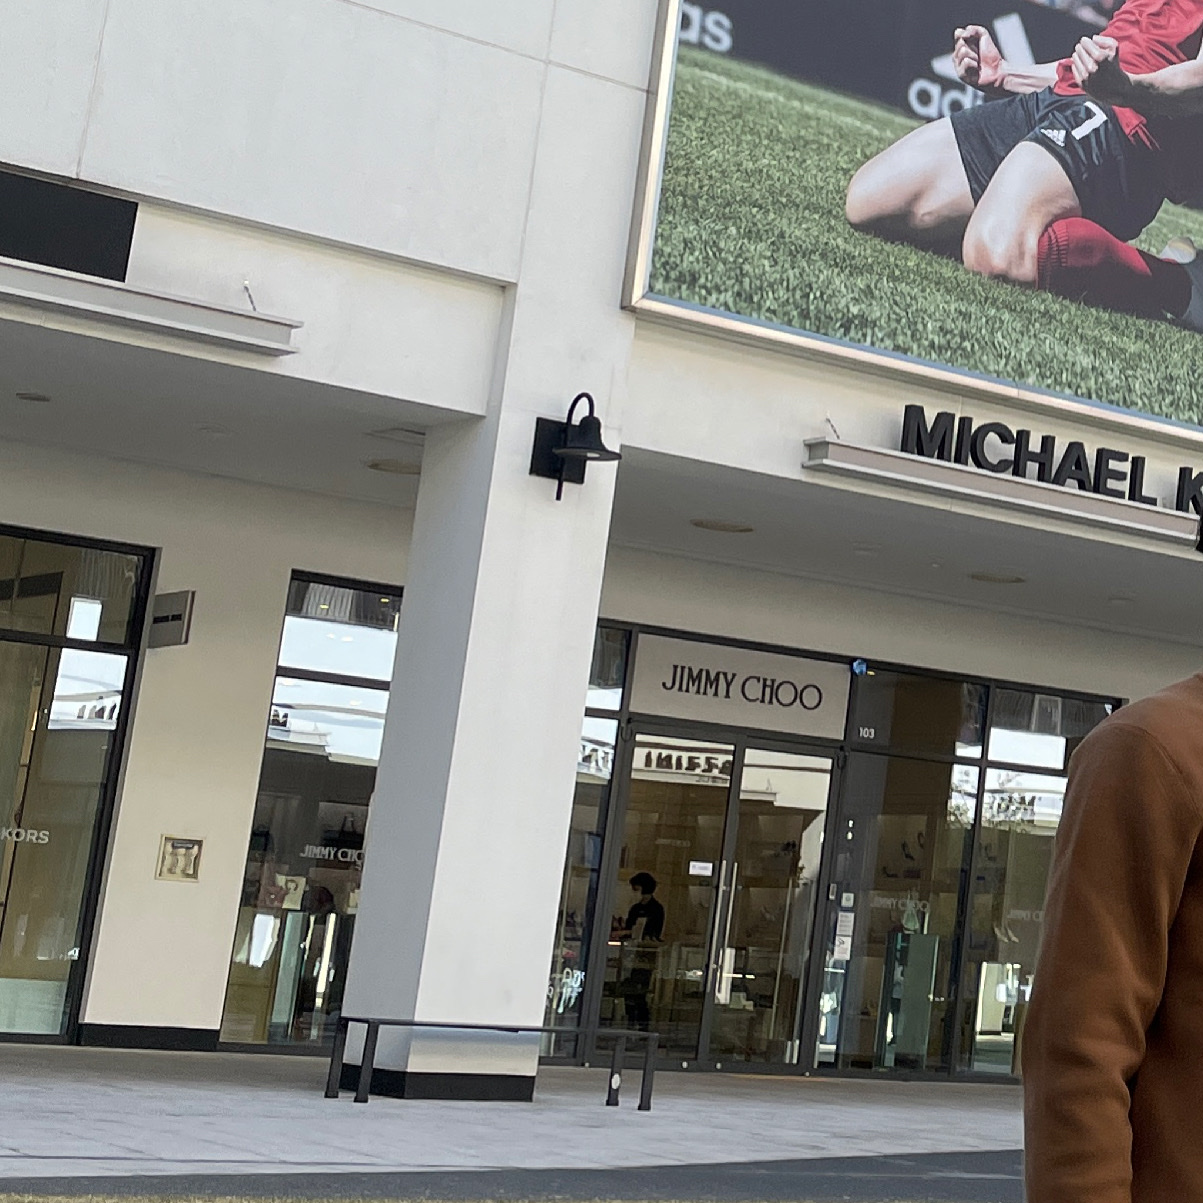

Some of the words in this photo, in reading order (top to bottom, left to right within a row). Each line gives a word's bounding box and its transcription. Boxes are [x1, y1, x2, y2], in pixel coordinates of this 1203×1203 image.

[900, 403, 1158, 507] MICHAEL
[661, 664, 737, 699] JIMMY
[740, 675, 823, 710] CHOO
[0, 827, 50, 844] KORS
[300, 844, 337, 860] JIMMY
